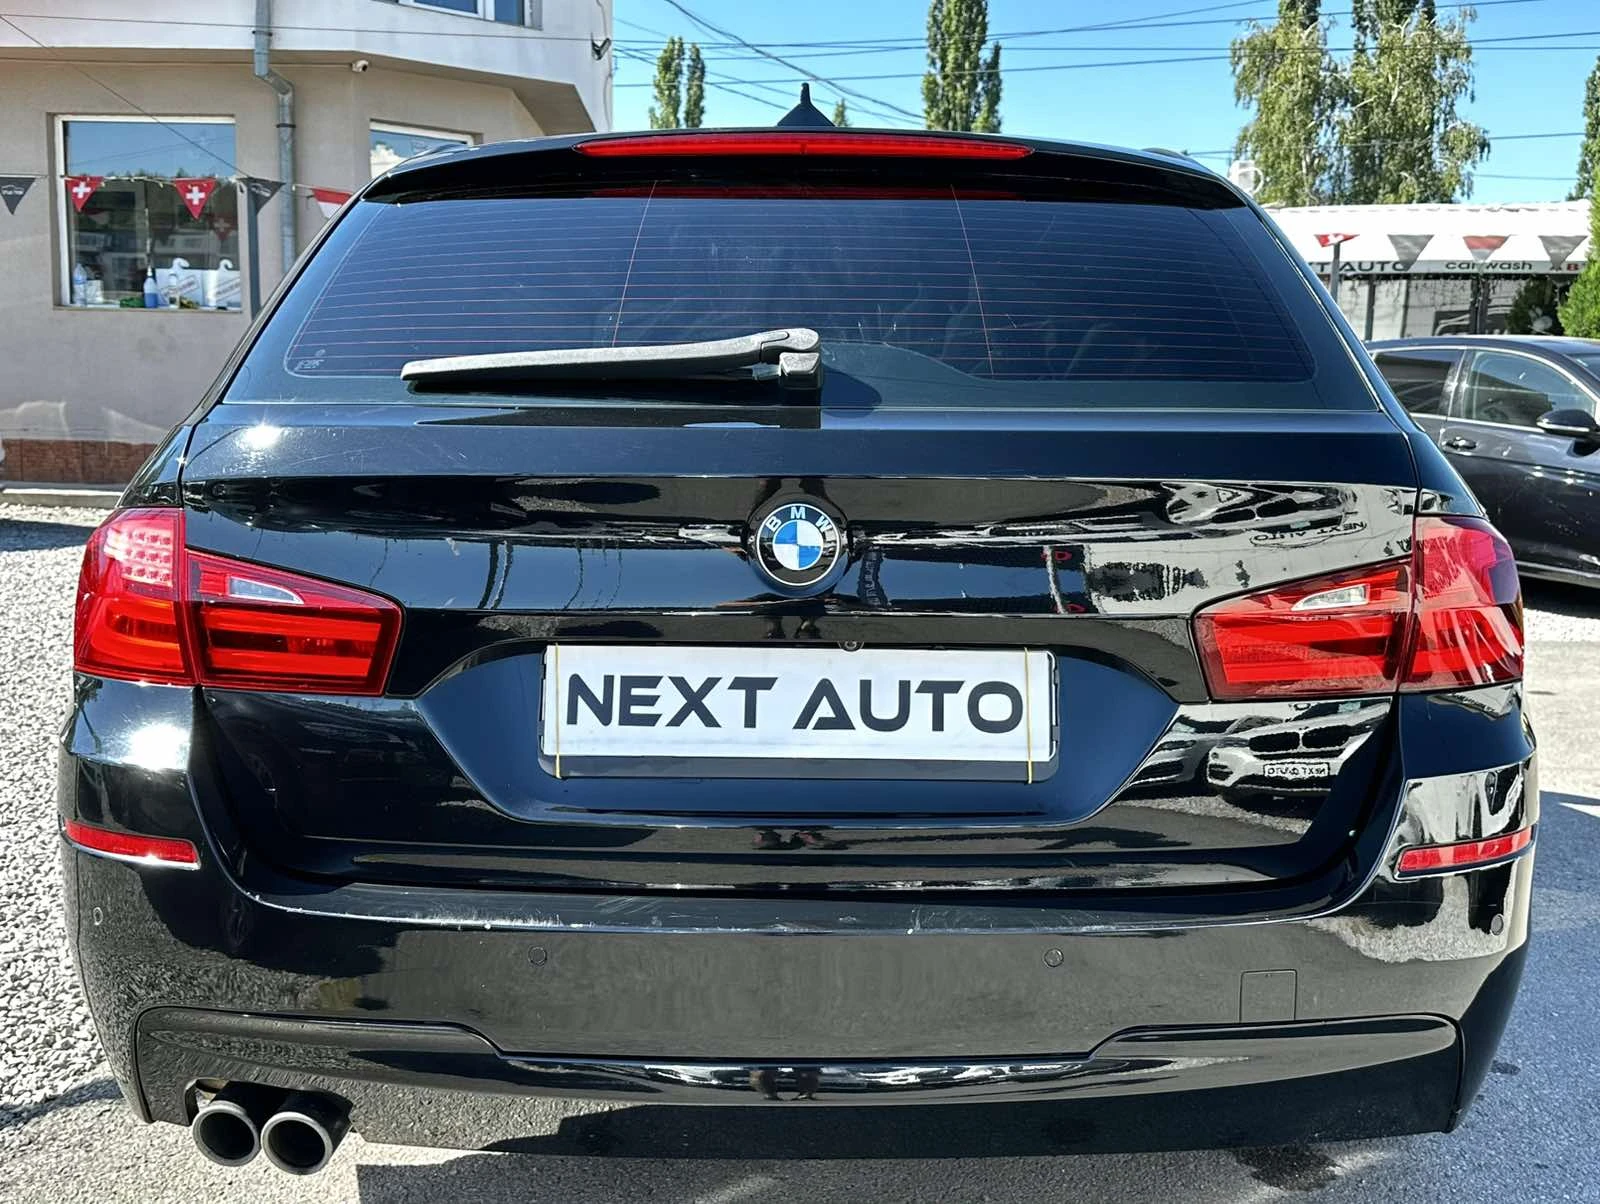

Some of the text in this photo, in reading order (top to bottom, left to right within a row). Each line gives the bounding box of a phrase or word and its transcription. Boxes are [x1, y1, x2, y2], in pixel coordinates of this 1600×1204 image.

[1339, 261, 1408, 272] AUTO
[1486, 260, 1533, 271] wash
[765, 506, 833, 533] BMW
[566, 673, 1023, 734] NEXT AUTO
